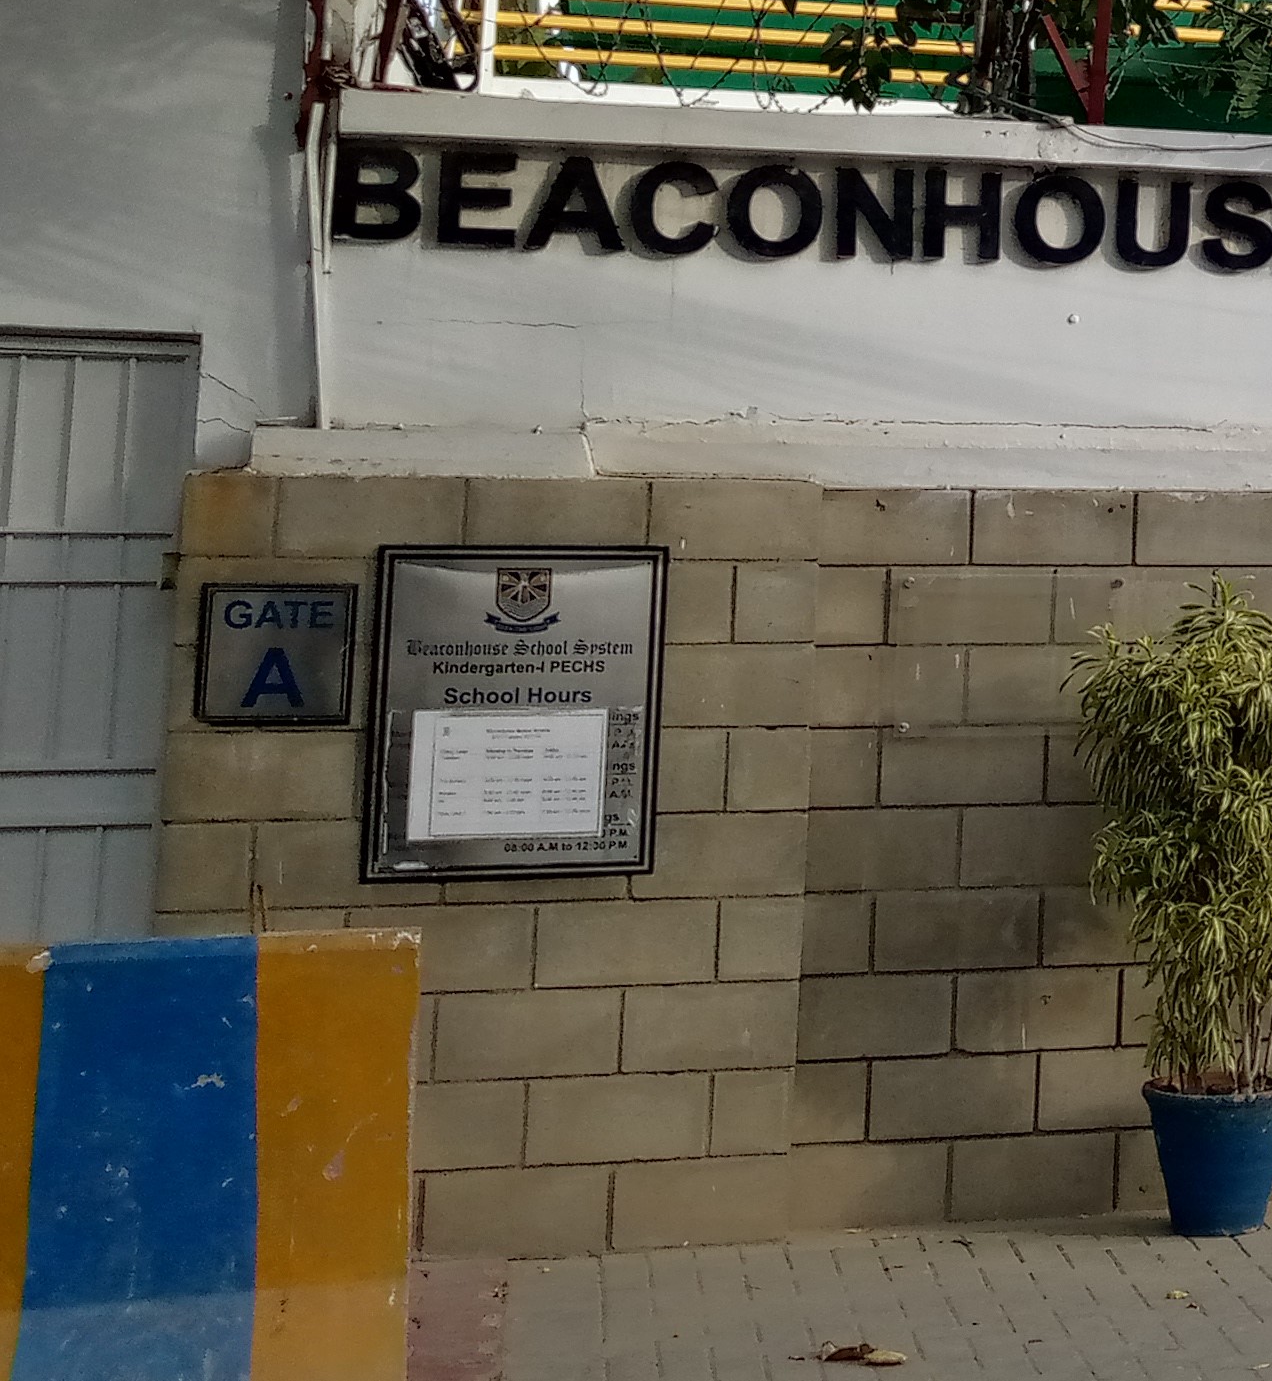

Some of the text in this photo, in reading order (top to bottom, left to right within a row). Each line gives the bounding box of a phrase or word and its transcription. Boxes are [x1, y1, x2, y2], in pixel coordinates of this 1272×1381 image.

[224, 599, 334, 630] GATE
[513, 639, 569, 656] School
[549, 660, 606, 674] PECHS
[240, 647, 305, 708] A
[443, 686, 593, 705] School Hours
